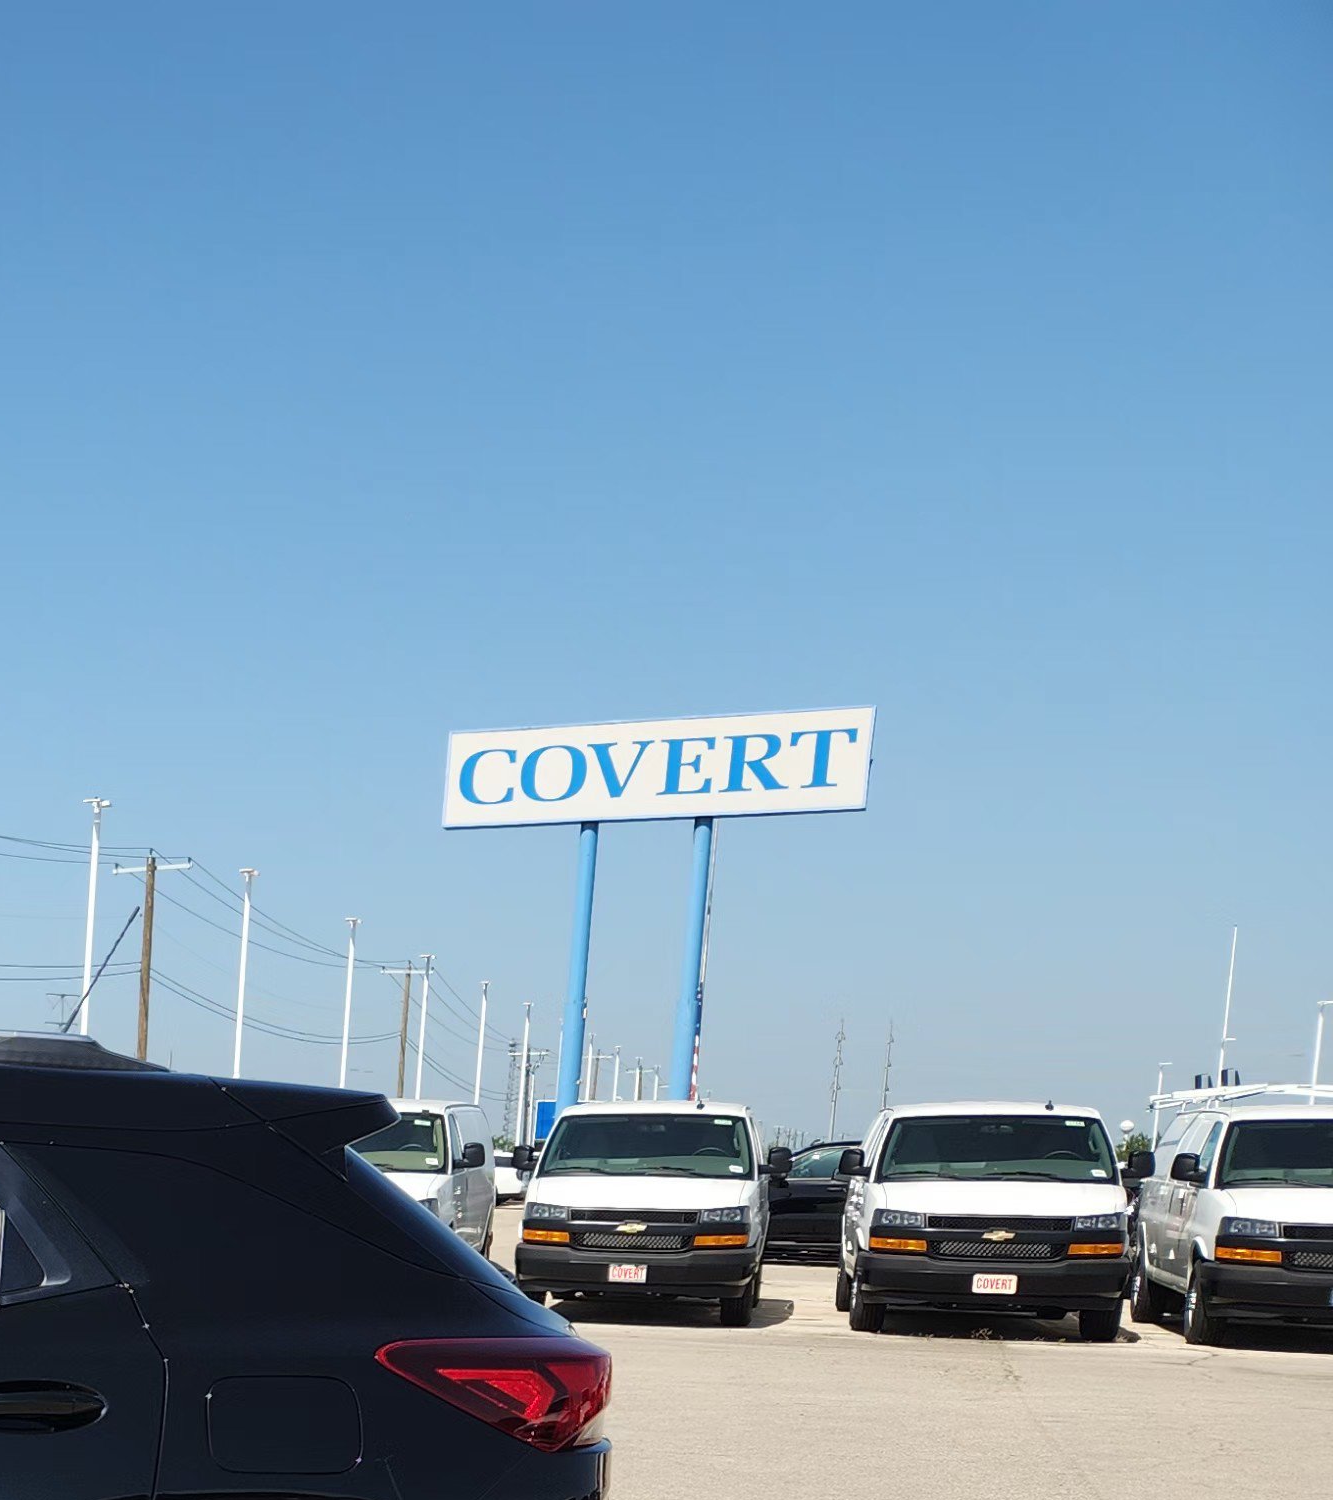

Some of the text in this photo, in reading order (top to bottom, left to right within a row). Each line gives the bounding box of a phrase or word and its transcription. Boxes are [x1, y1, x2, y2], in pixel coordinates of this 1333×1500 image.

[459, 728, 858, 805] COVERT
[613, 1265, 645, 1279] COVERT
[976, 1277, 1013, 1290] COVERT
